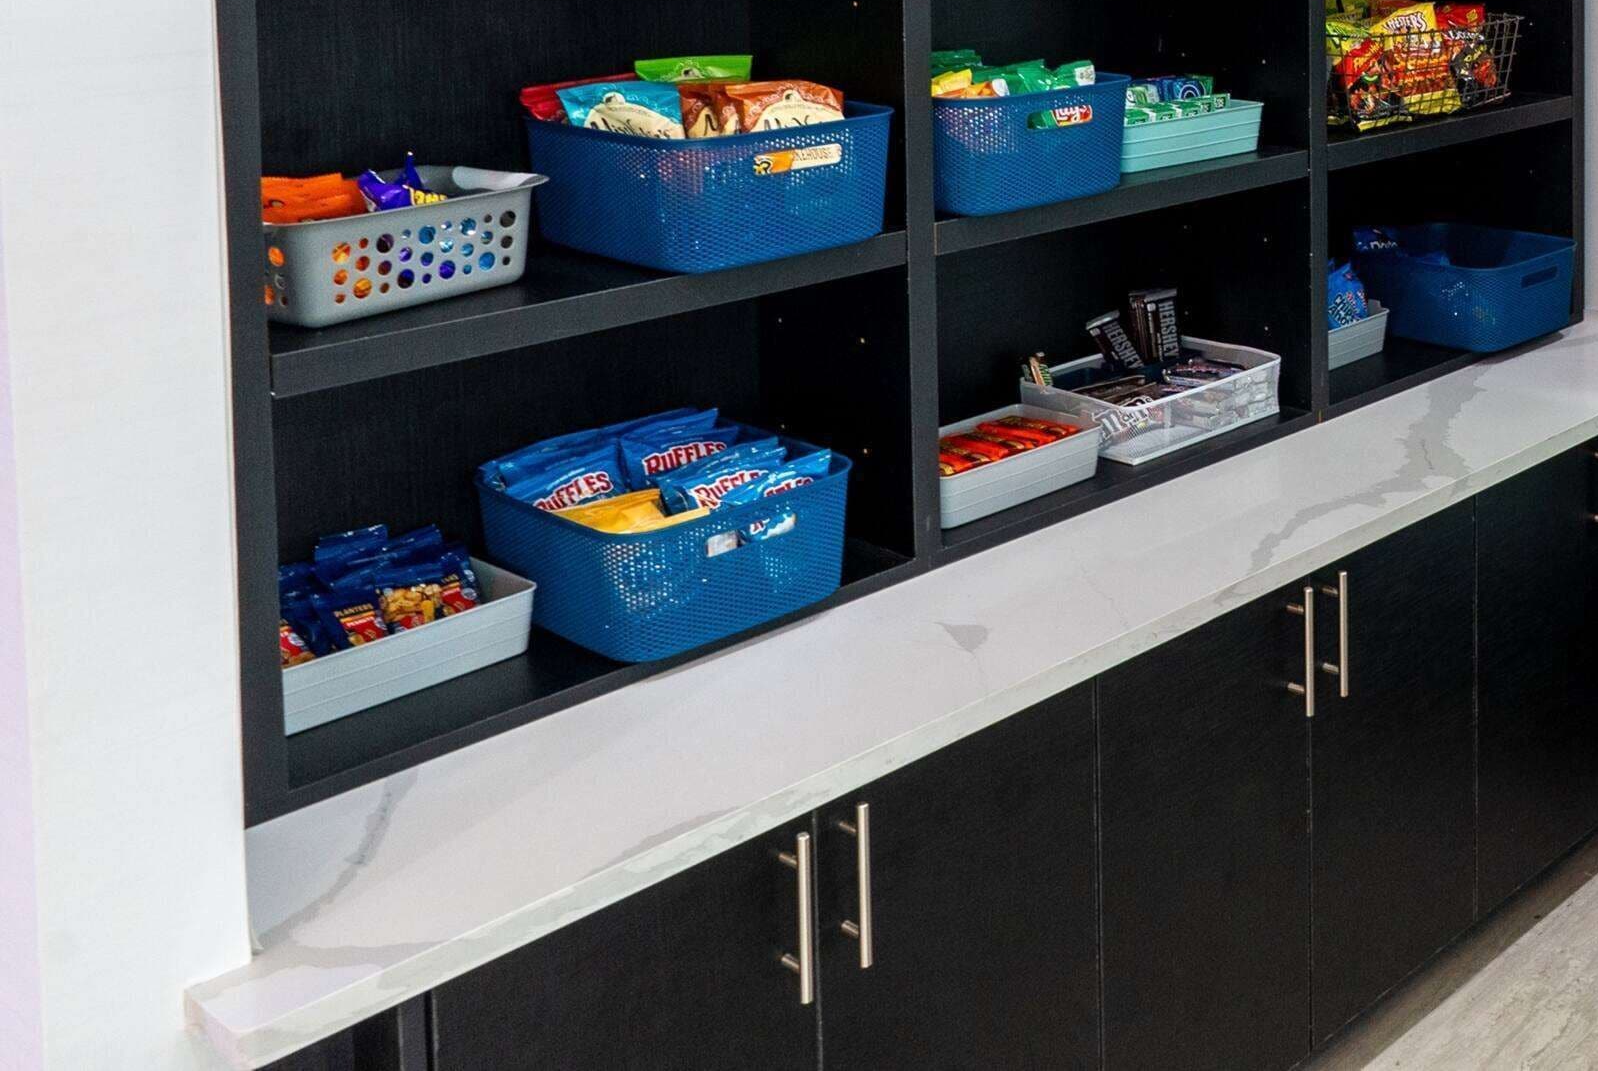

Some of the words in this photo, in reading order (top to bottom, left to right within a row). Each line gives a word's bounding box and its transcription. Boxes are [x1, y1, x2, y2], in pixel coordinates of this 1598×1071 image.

[644, 441, 727, 476] RUFFLES
[694, 469, 768, 509] RUFFLE
[334, 603, 374, 618] PLANTERS
